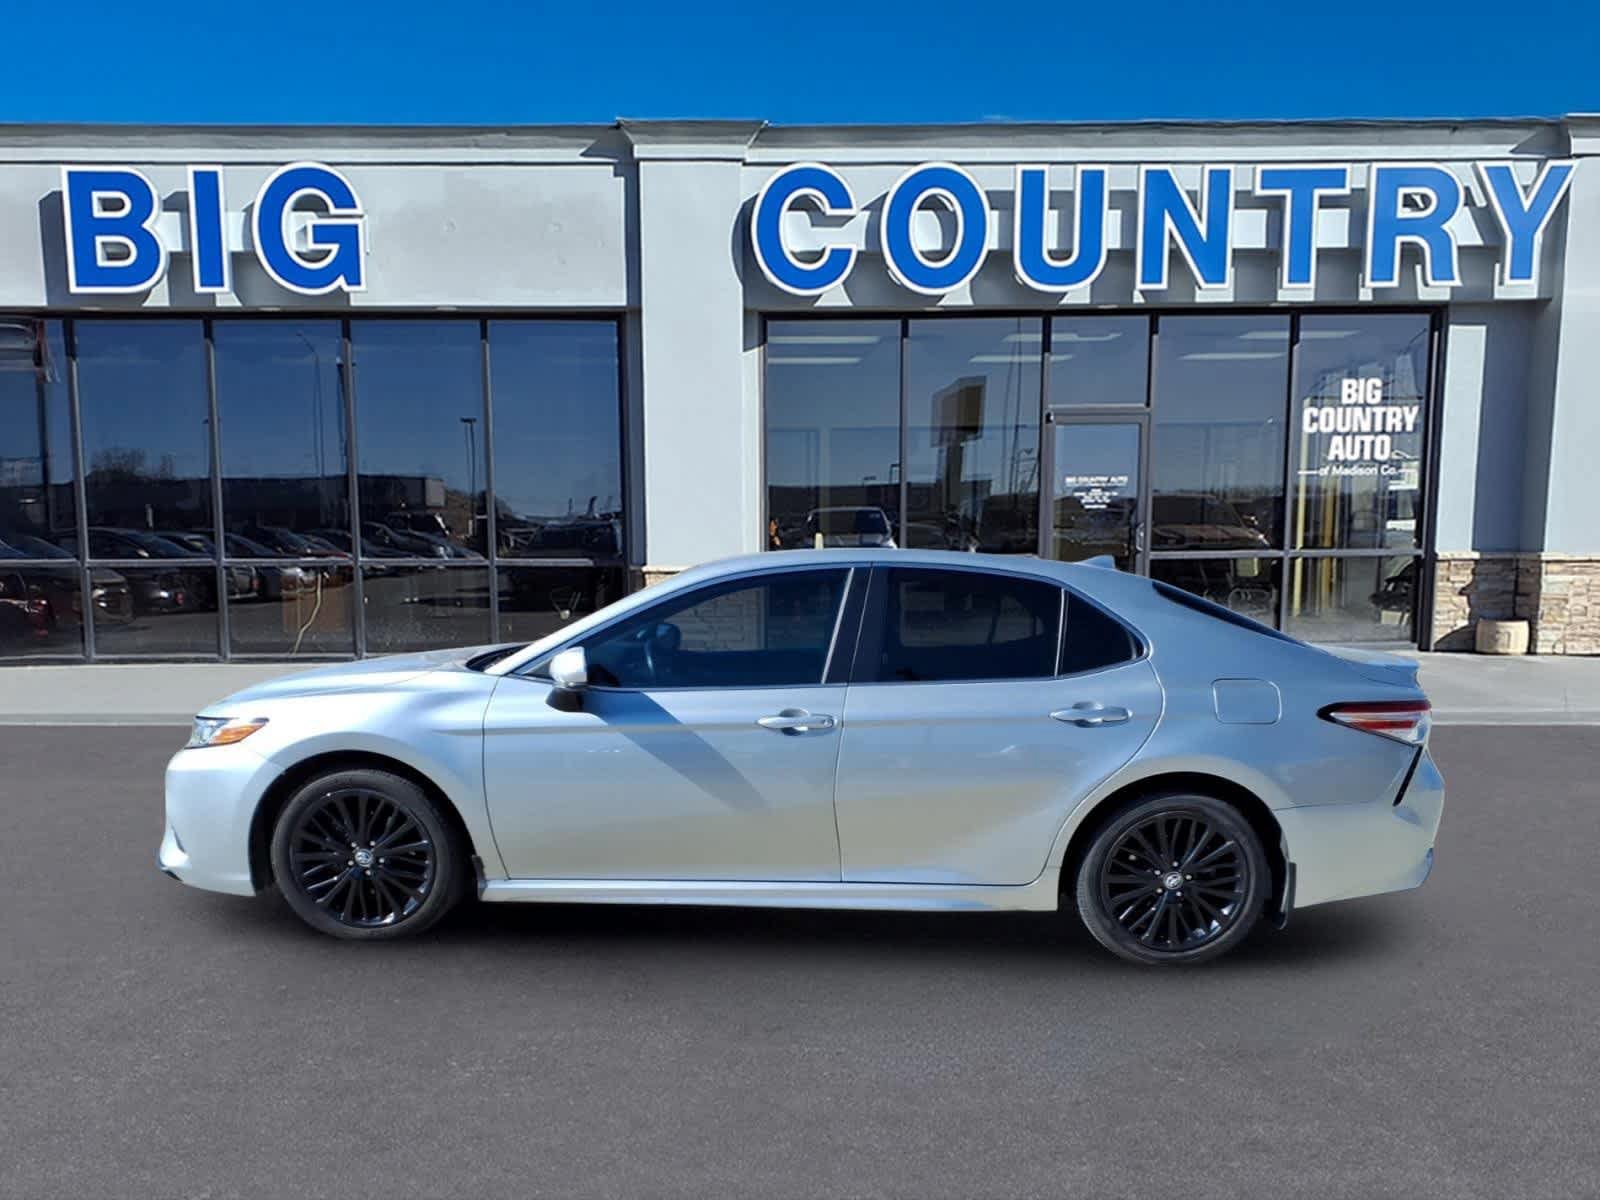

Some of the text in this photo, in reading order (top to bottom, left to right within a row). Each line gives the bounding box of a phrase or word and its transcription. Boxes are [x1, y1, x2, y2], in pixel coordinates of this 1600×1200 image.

[61, 161, 1578, 296] BIG COUNTRY
[1341, 377, 1383, 404] BIG
[1302, 405, 1419, 432] COUNTRY
[1327, 434, 1391, 460] AUTO
[1319, 464, 1330, 476] of
[1331, 464, 1377, 475] Madison
